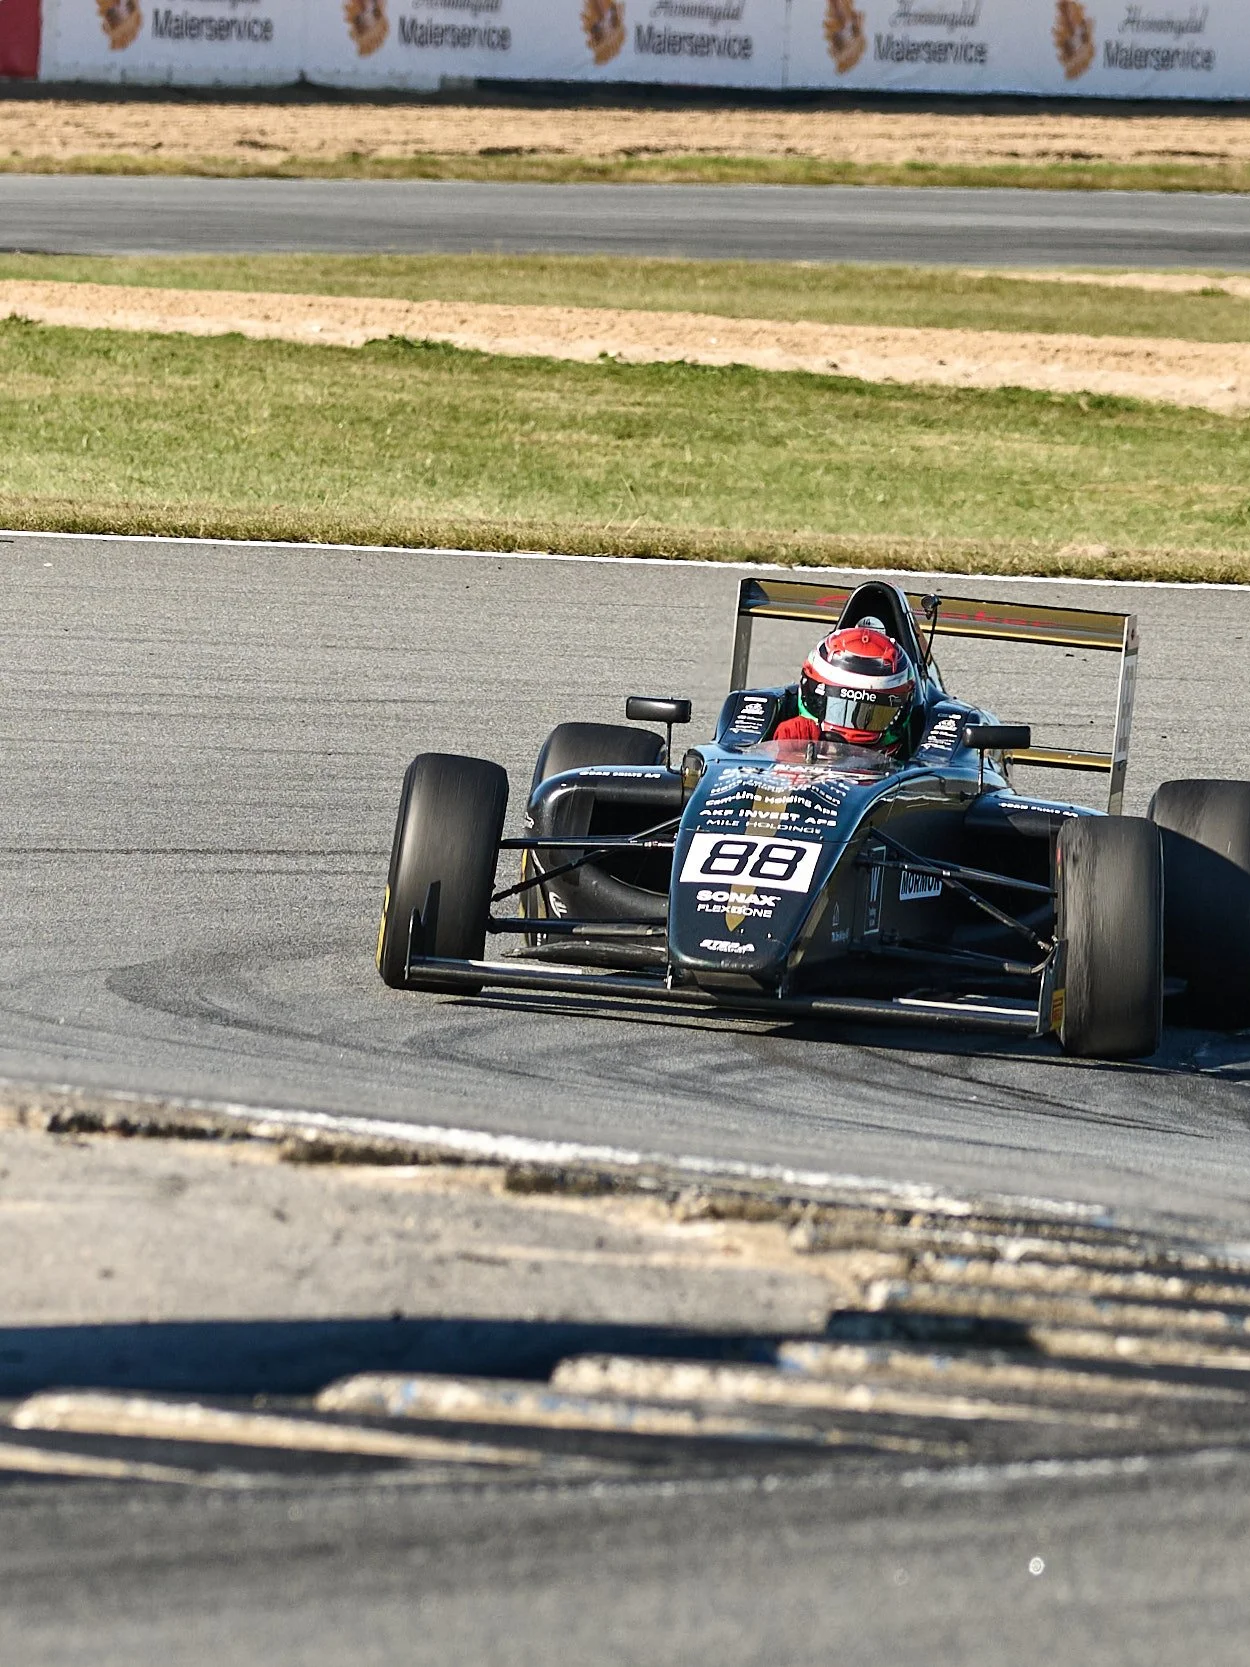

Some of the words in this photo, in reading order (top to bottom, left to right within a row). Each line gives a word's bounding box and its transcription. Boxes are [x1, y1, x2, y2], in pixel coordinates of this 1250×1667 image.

[152, 9, 273, 42] Malerservice
[398, 17, 512, 52] Malerservice
[634, 24, 753, 60] Malerservice
[873, 34, 988, 65] Malerservice
[1103, 41, 1216, 71] Malerservice
[840, 688, 877, 701] saphe
[738, 808, 801, 821] INVEST
[699, 840, 807, 881] 88
[696, 890, 781, 907] SONAX
